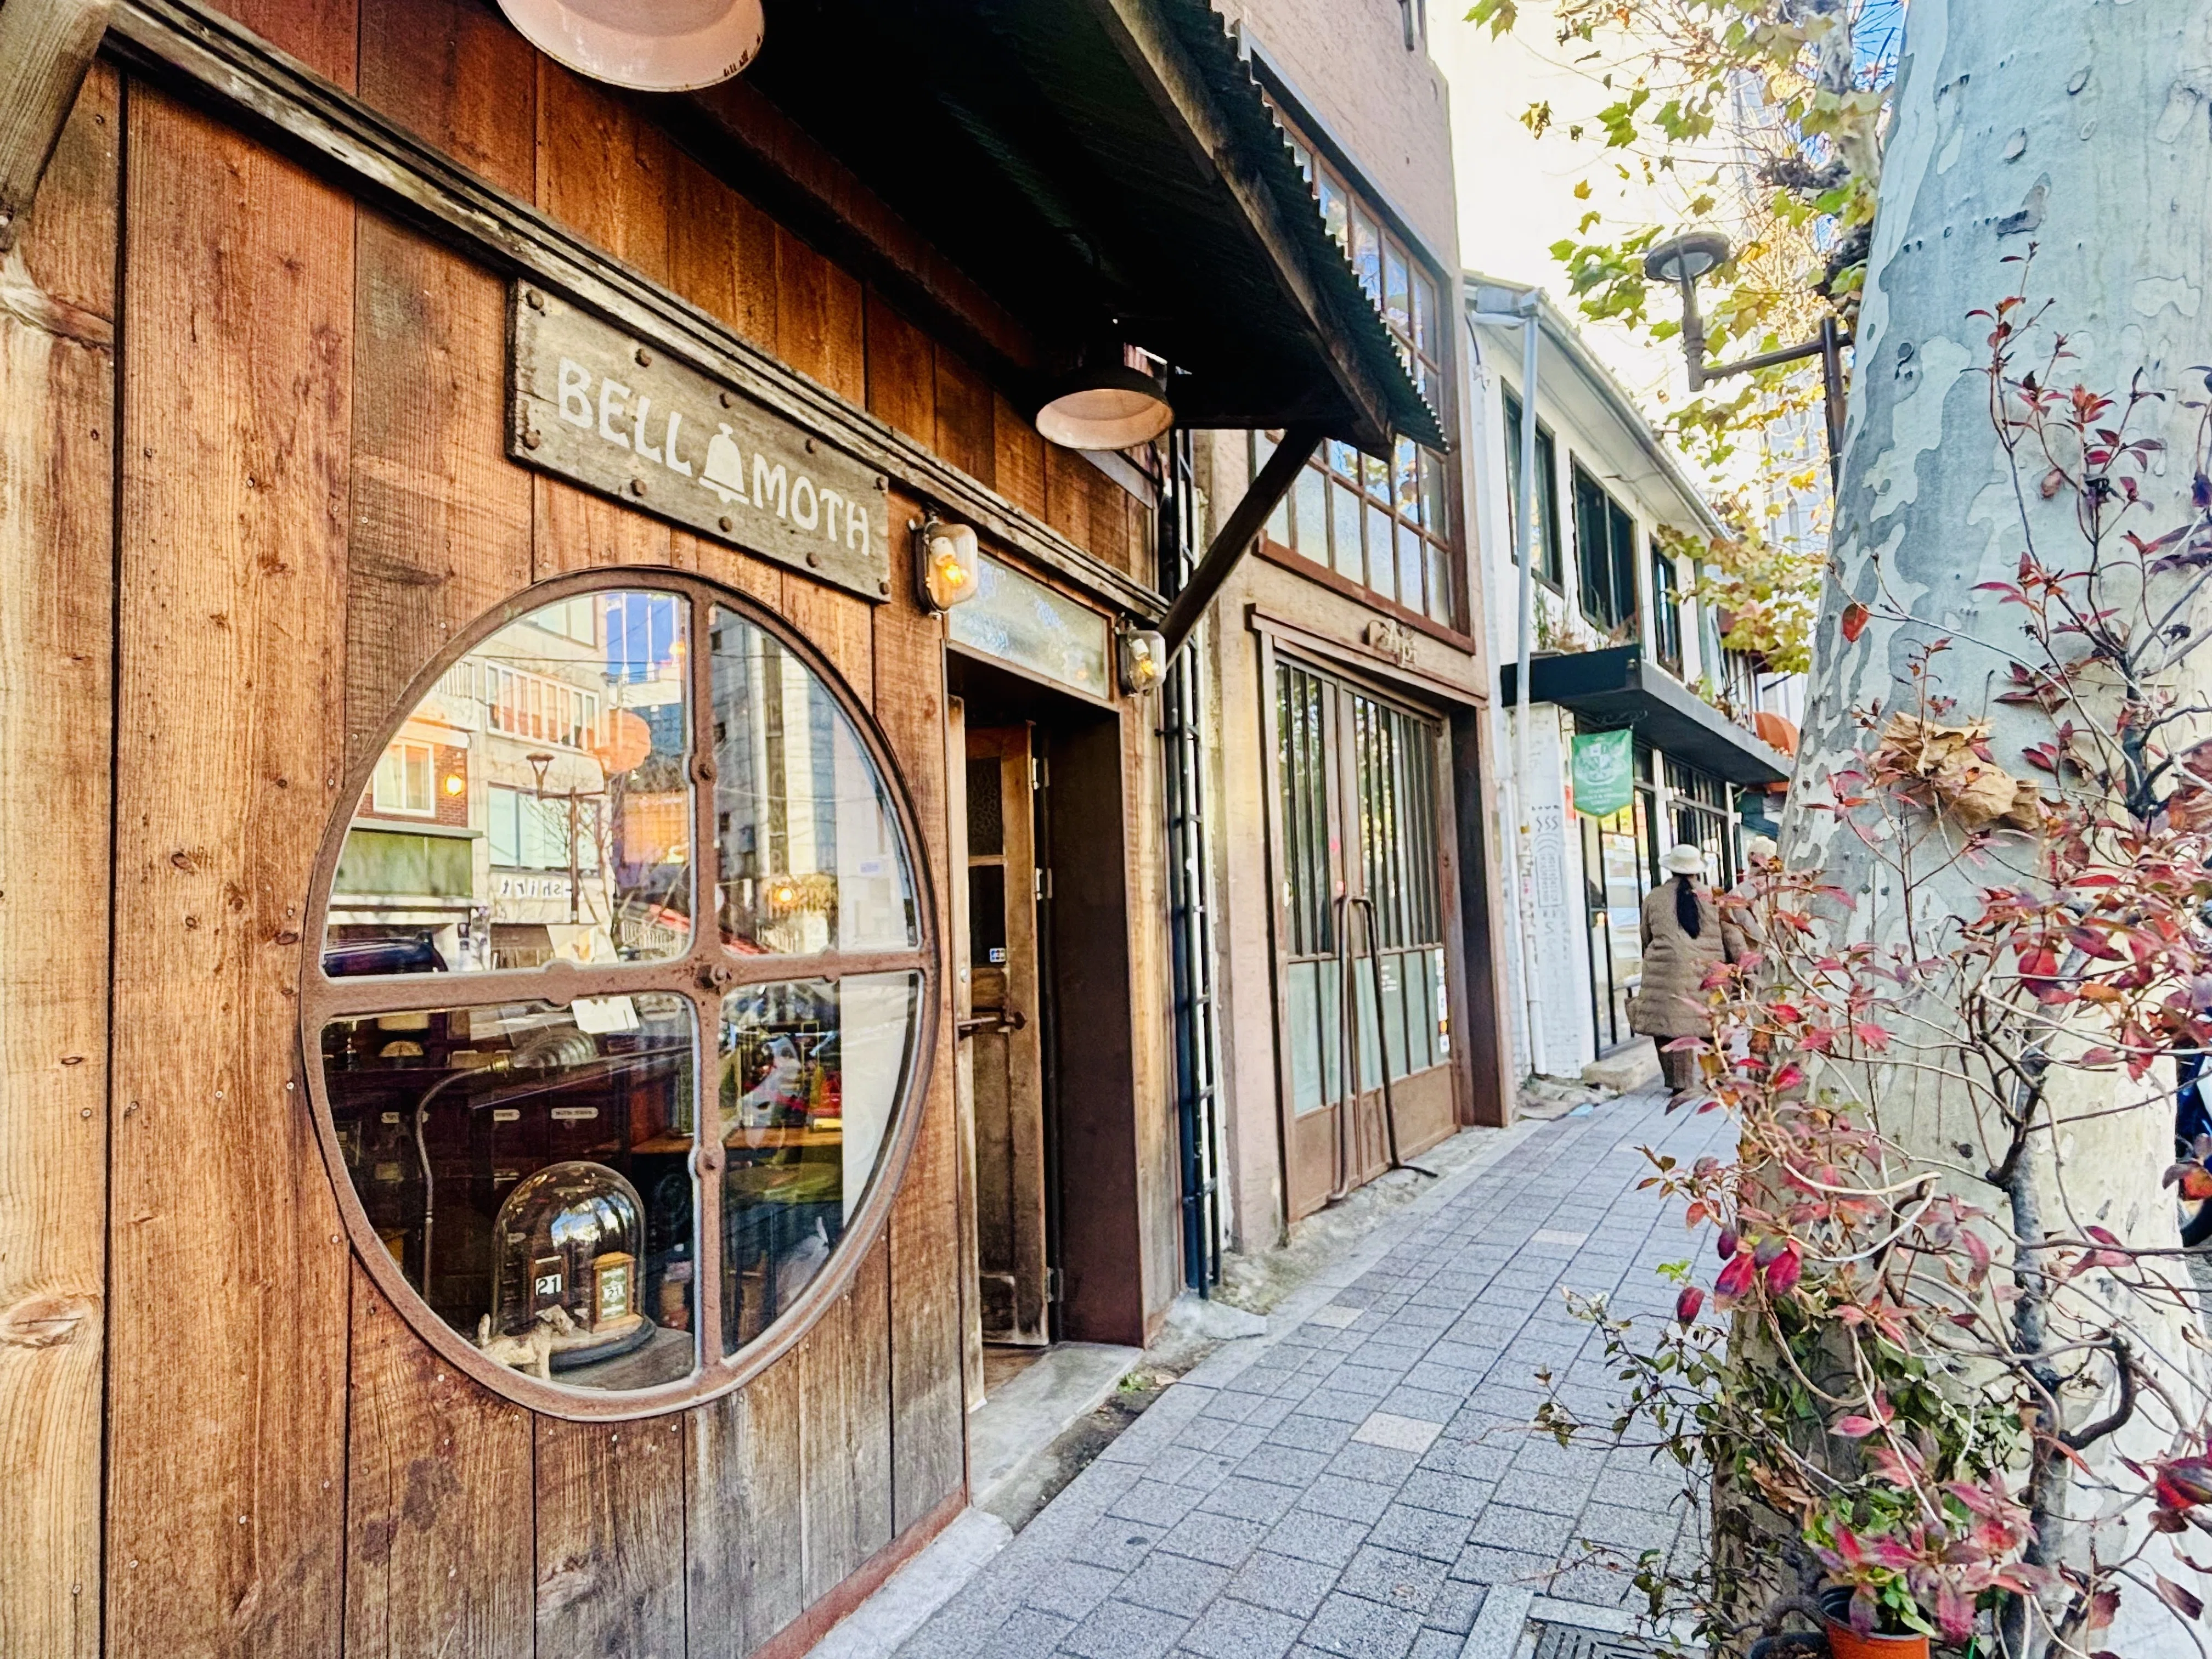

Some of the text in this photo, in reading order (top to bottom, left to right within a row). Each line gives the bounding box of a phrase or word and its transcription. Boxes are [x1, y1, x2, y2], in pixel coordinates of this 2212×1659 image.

[557, 357, 870, 555] BELL MOTH
[538, 1277, 557, 1295] 21
[608, 1289, 620, 1298] 21
